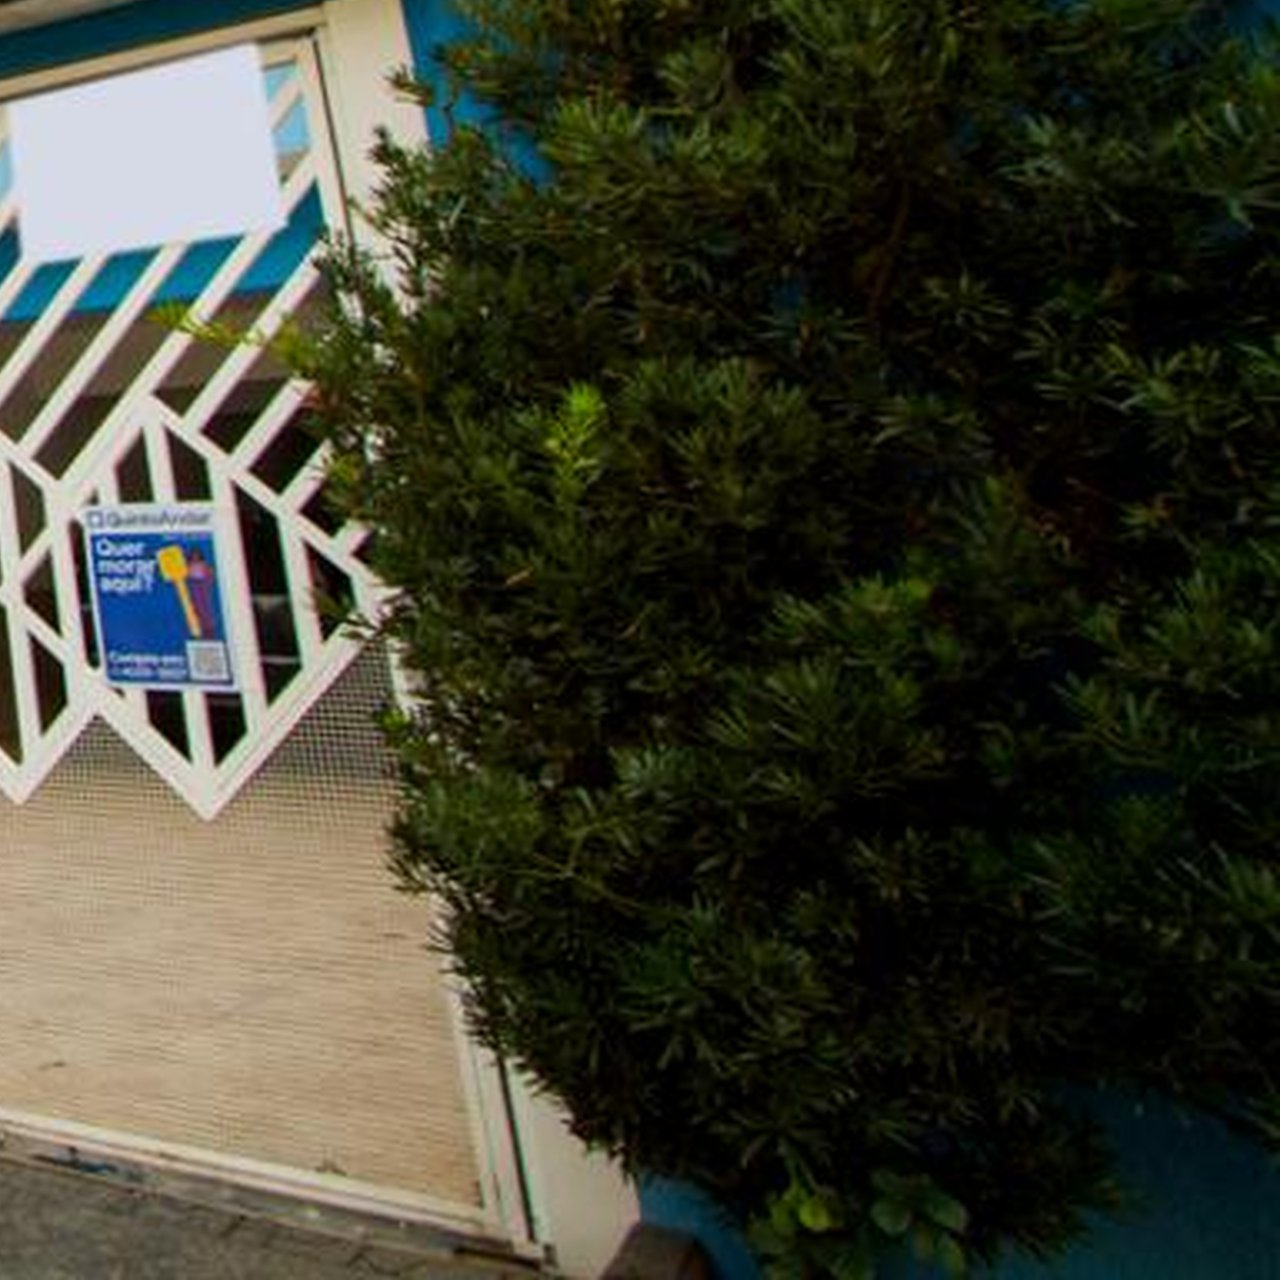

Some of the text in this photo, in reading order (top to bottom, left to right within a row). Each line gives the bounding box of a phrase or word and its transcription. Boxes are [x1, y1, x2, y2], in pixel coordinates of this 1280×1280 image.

[96, 538, 145, 557] Quer
[98, 560, 156, 574] morar
[100, 576, 154, 594] aqui?
